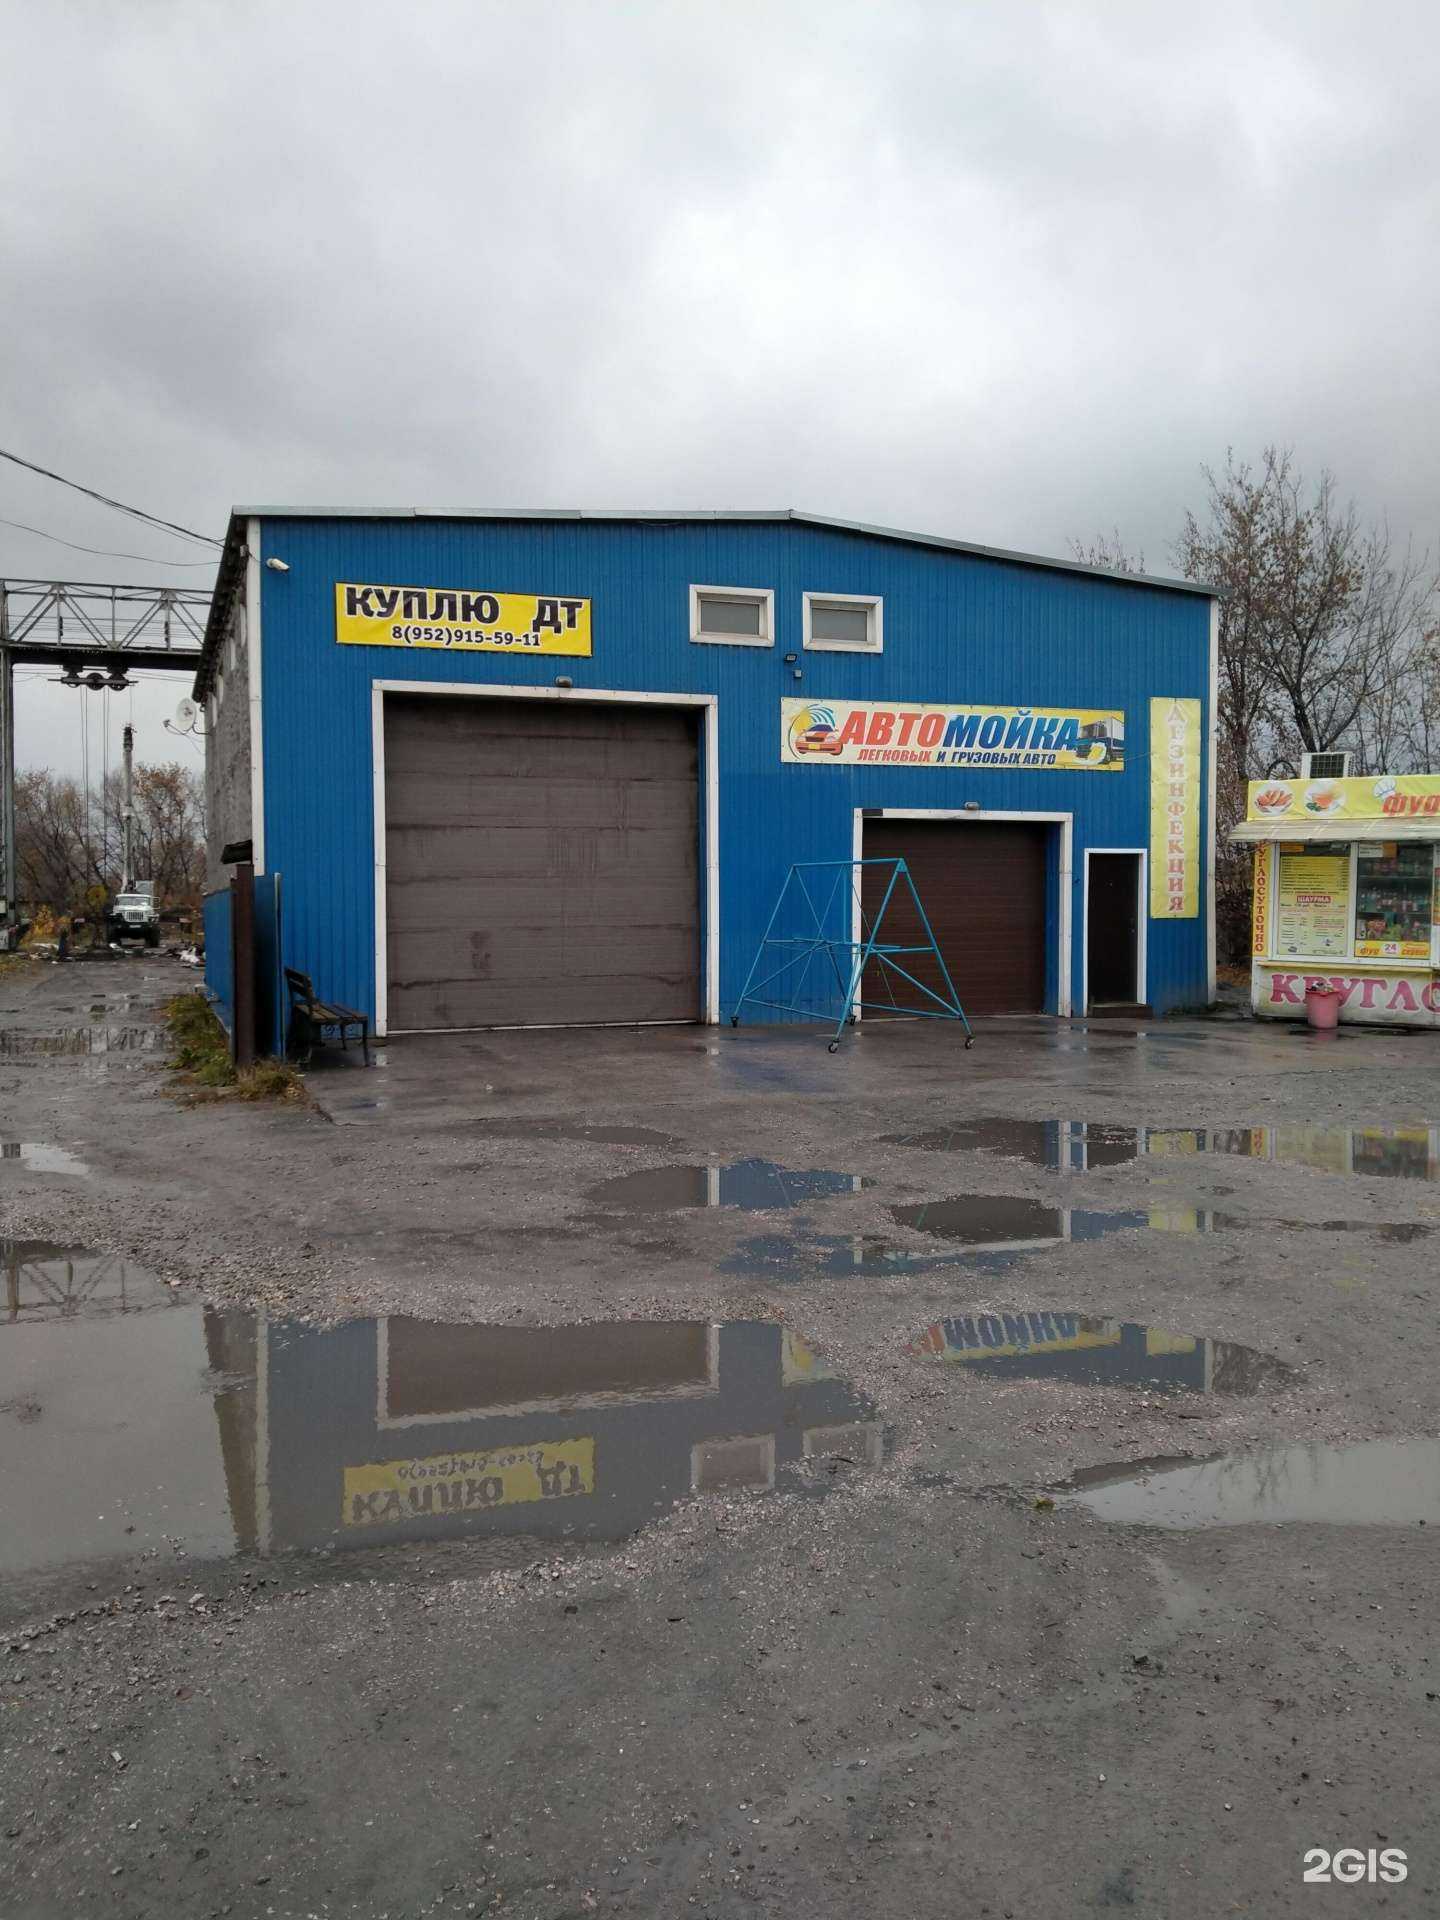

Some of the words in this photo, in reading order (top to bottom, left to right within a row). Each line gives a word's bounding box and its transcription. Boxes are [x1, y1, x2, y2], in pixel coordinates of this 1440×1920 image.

[346, 586, 500, 624] КУПЛЮ
[532, 599, 583, 634] ДТ
[391, 626, 541, 647] 8(952)915-59-11
[840, 707, 1081, 751] АВТОМОЙКА
[857, 748, 932, 763] ЛЕГКОВЫХ
[936, 751, 947, 763] И
[950, 751, 1021, 765] ГРУЗОВЫХ
[1022, 753, 1057, 765] АВТО
[1167, 704, 1186, 912] ДЕЗИНФЕКЦИЯ
[1384, 943, 1397, 951] 24
